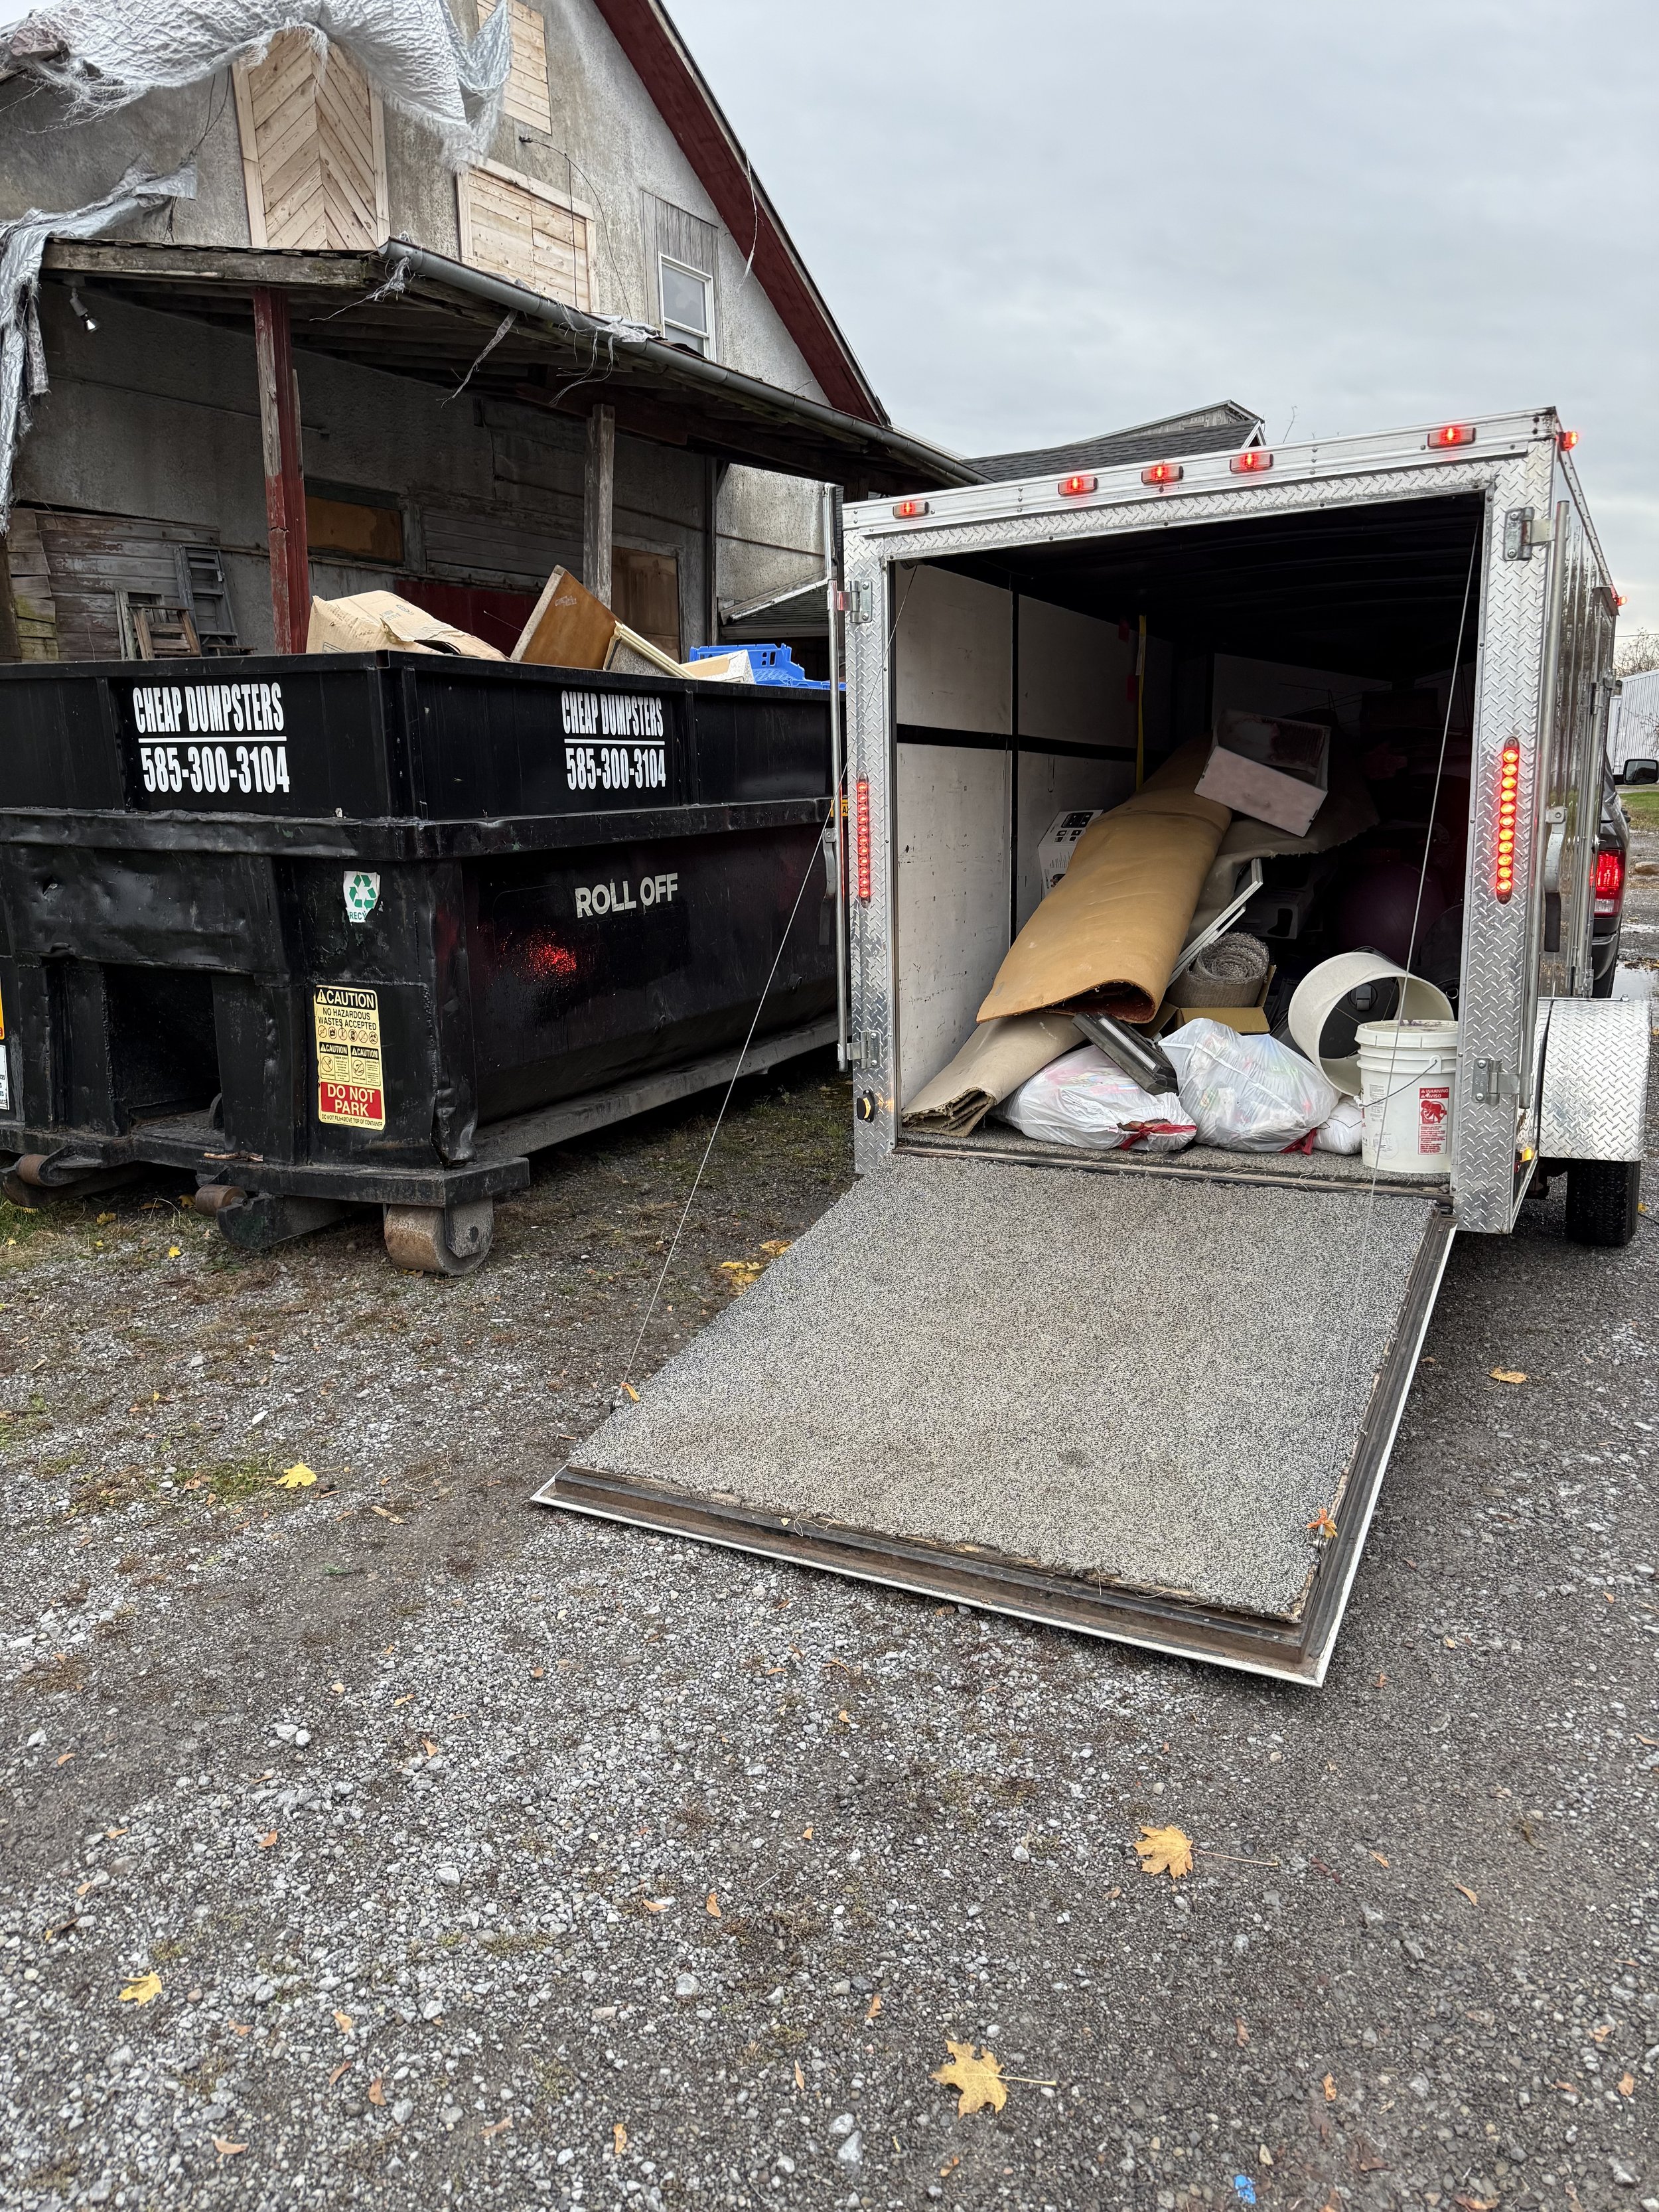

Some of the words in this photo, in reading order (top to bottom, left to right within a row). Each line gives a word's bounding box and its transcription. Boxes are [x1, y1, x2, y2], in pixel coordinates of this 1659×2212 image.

[133, 686, 182, 733] CHEAP
[184, 682, 284, 733] DUMPSTERS
[561, 690, 598, 734] CHEAP
[600, 694, 664, 737] DUMPSTERS
[140, 745, 290, 794] 585-300-3104
[565, 747, 666, 790] 585-300-3104
[575, 881, 637, 919] ROLL
[640, 872, 678, 907] OFF
[326, 990, 374, 1009] CAUTION
[318, 1016, 343, 1027] WASTES
[344, 1019, 377, 1031] ACCEPTED
[323, 1007, 332, 1016] NO
[332, 1008, 371, 1021] HAZARDOUS
[326, 1044, 348, 1054] CAUTION
[356, 1048, 378, 1059] CAUTION
[327, 1084, 346, 1099] DO
[349, 1086, 375, 1103] NOT
[334, 1099, 369, 1117] PARK
